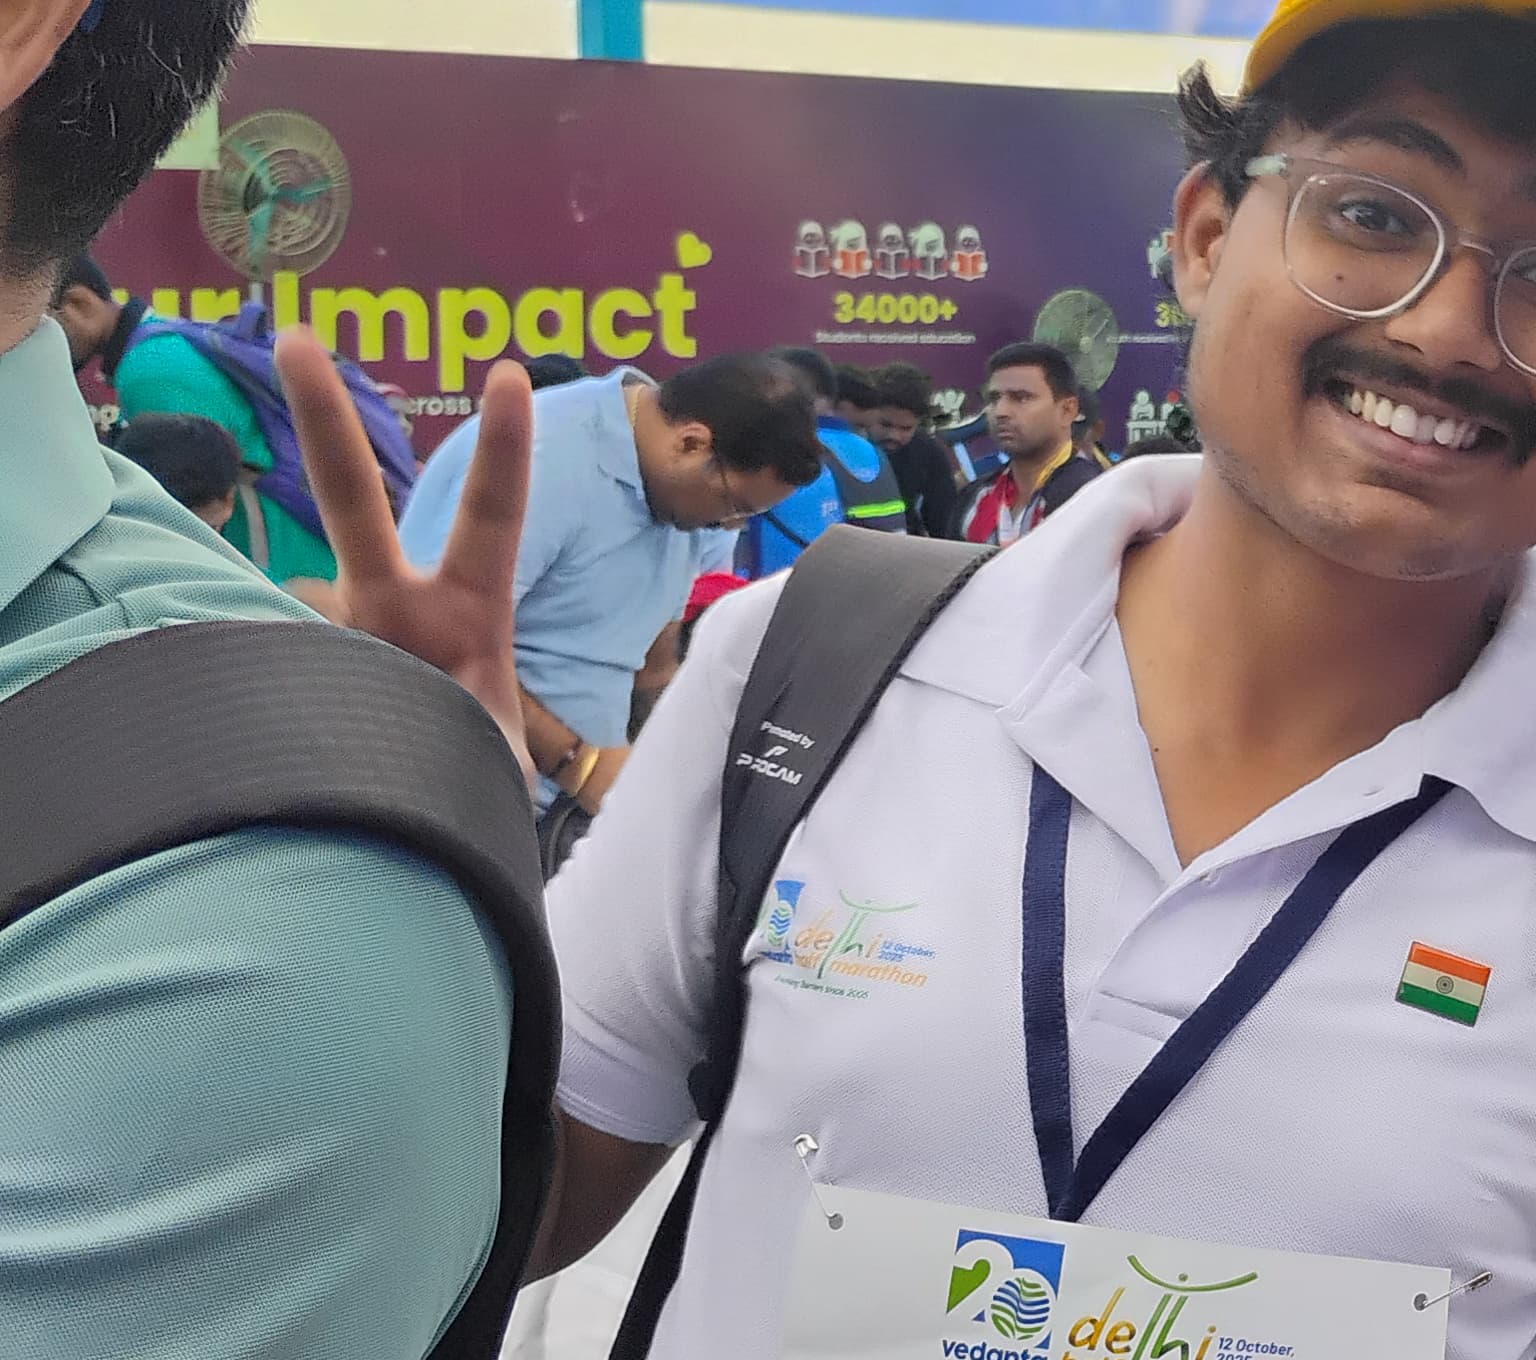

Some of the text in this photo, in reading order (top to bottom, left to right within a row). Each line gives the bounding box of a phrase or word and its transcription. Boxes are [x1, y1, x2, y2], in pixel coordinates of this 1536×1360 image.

[834, 292, 959, 324] 34000+
[272, 272, 697, 392] Impact
[406, 395, 473, 415] cross
[830, 959, 929, 987] marathon
[1217, 1336, 1295, 1358] 12 October,
